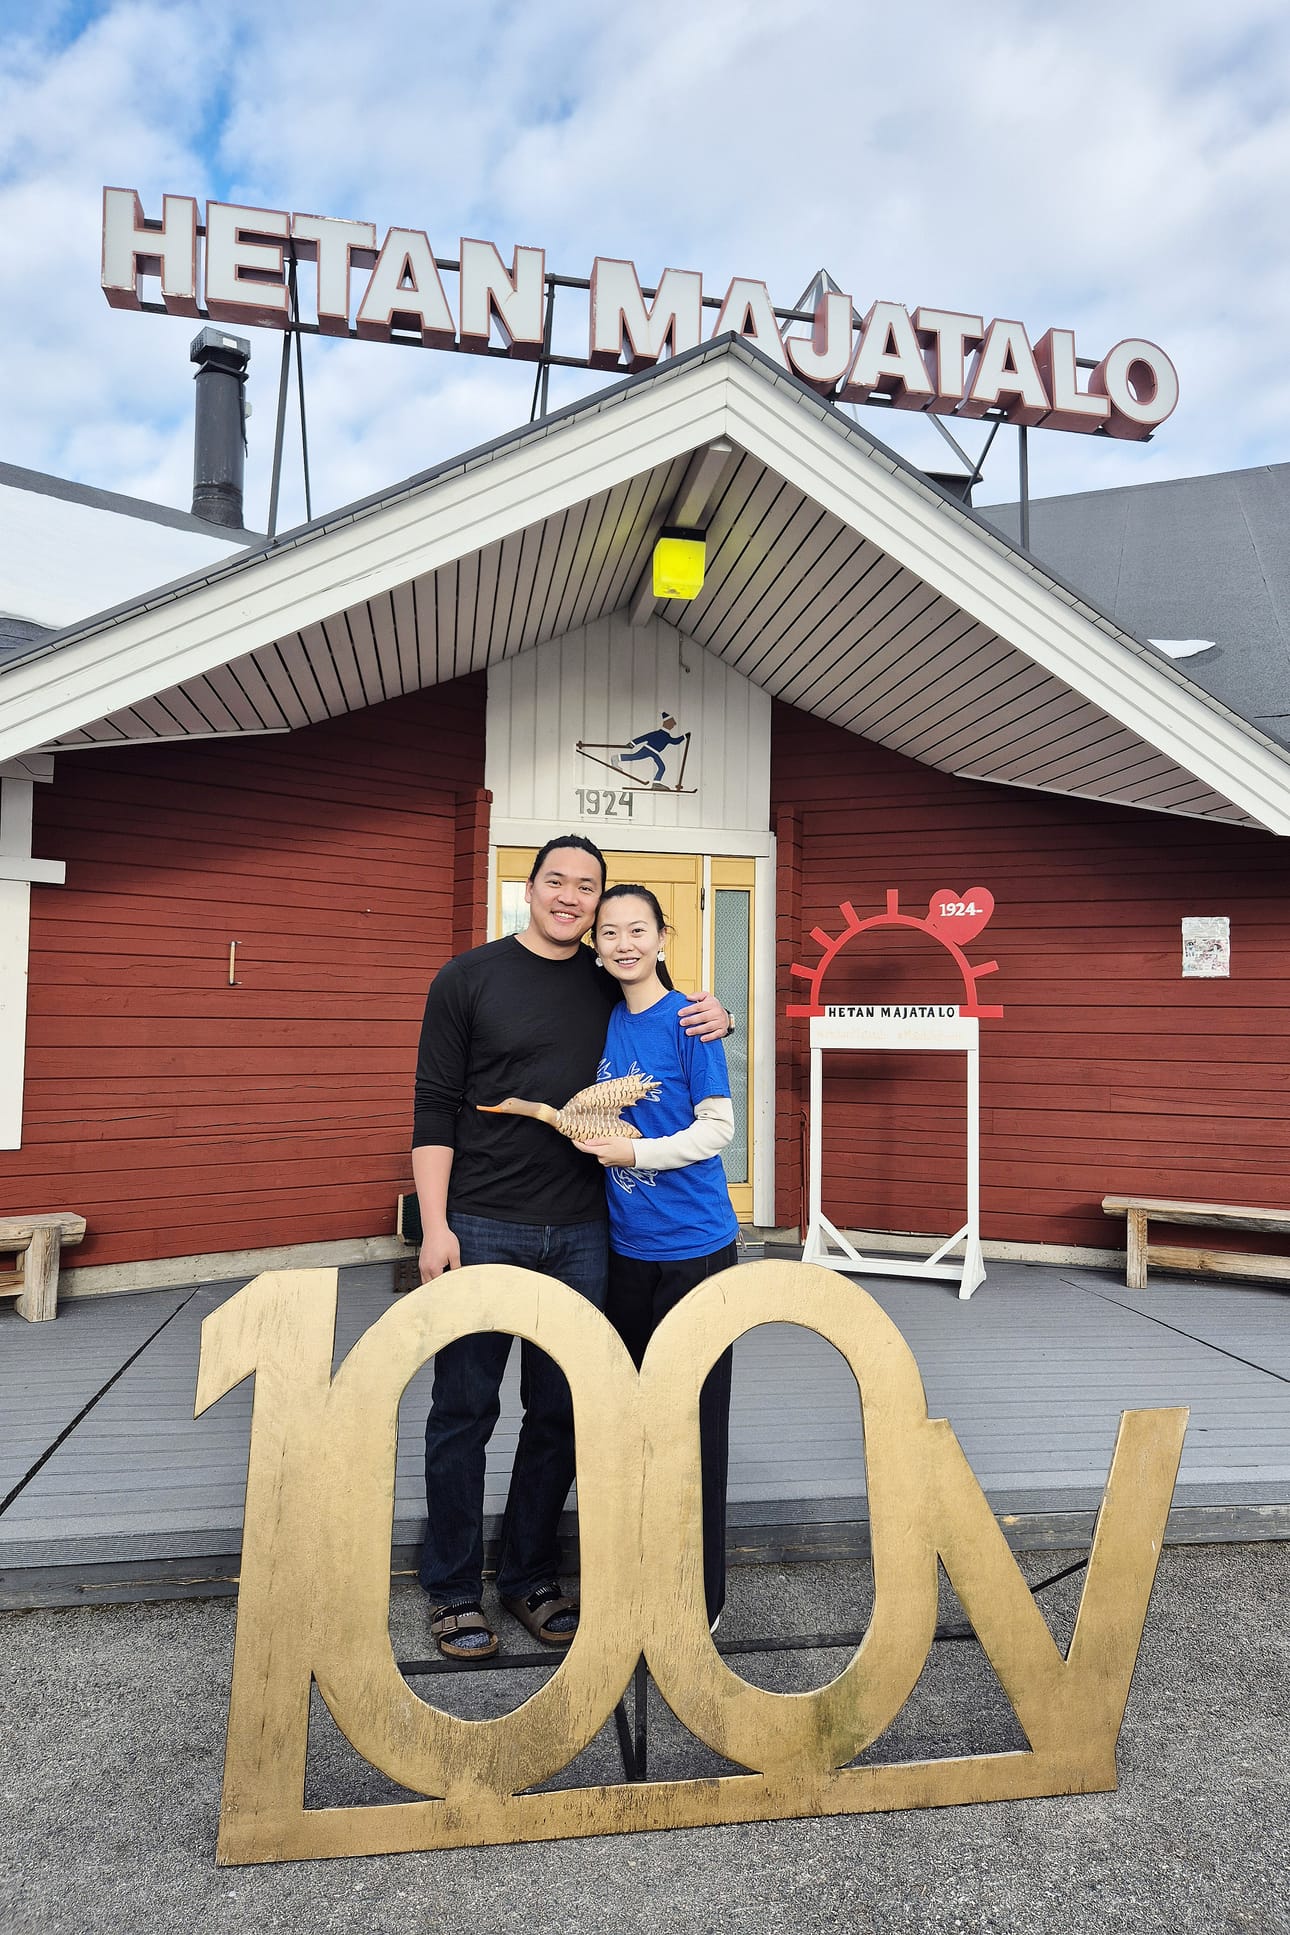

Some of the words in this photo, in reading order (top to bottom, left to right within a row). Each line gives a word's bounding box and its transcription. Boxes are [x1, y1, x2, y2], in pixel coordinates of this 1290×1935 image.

[101, 186, 546, 352] HETAN
[589, 256, 1180, 435] MAJATALO
[575, 788, 634, 817] 1924
[938, 902, 983, 916] 1924-
[828, 1007, 875, 1018] HETAN
[880, 1006, 955, 1020] MAJATALO
